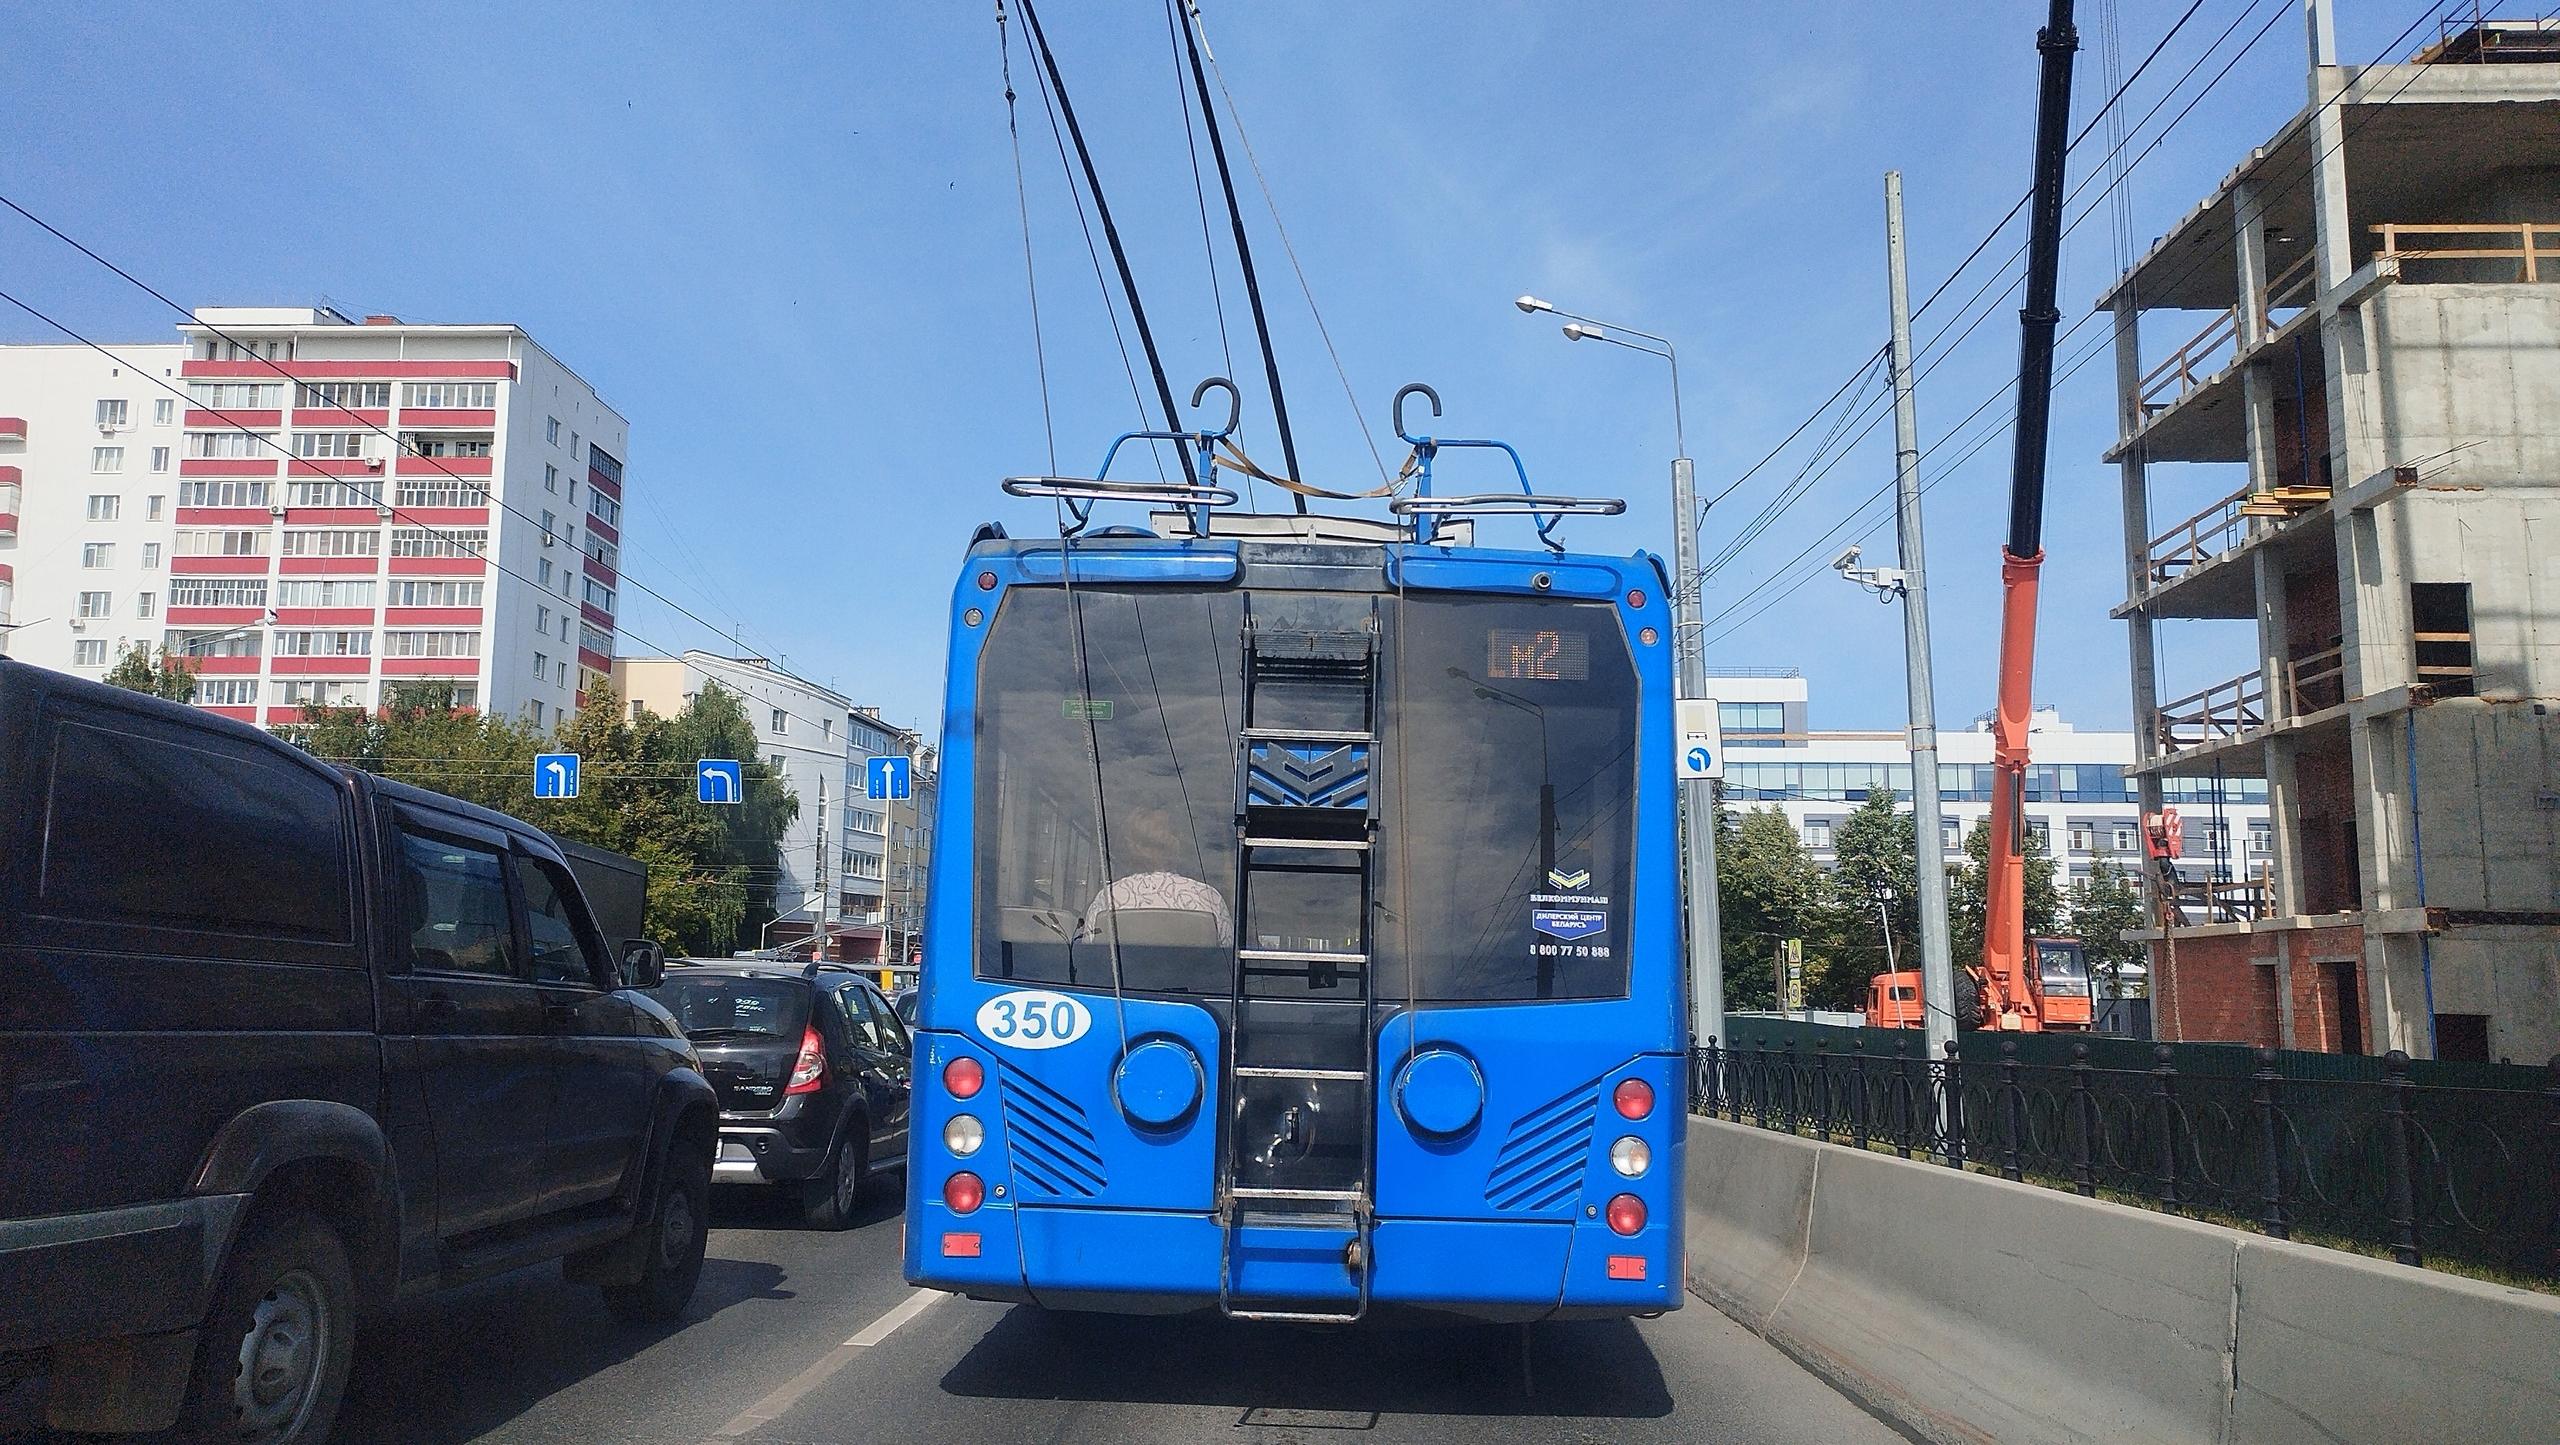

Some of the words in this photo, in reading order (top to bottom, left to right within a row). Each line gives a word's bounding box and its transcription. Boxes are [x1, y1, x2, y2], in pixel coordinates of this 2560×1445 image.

[1536, 912, 1579, 921] ДИЛЕРСКИЙ
[1580, 914, 1603, 922] ЦЕНТР
[1529, 944, 1536, 955] 8
[1539, 944, 1558, 956] 800
[1560, 945, 1573, 957] 77
[1576, 945, 1589, 958] 50
[1591, 946, 1610, 958] 888
[992, 1000, 1075, 1040] 350
